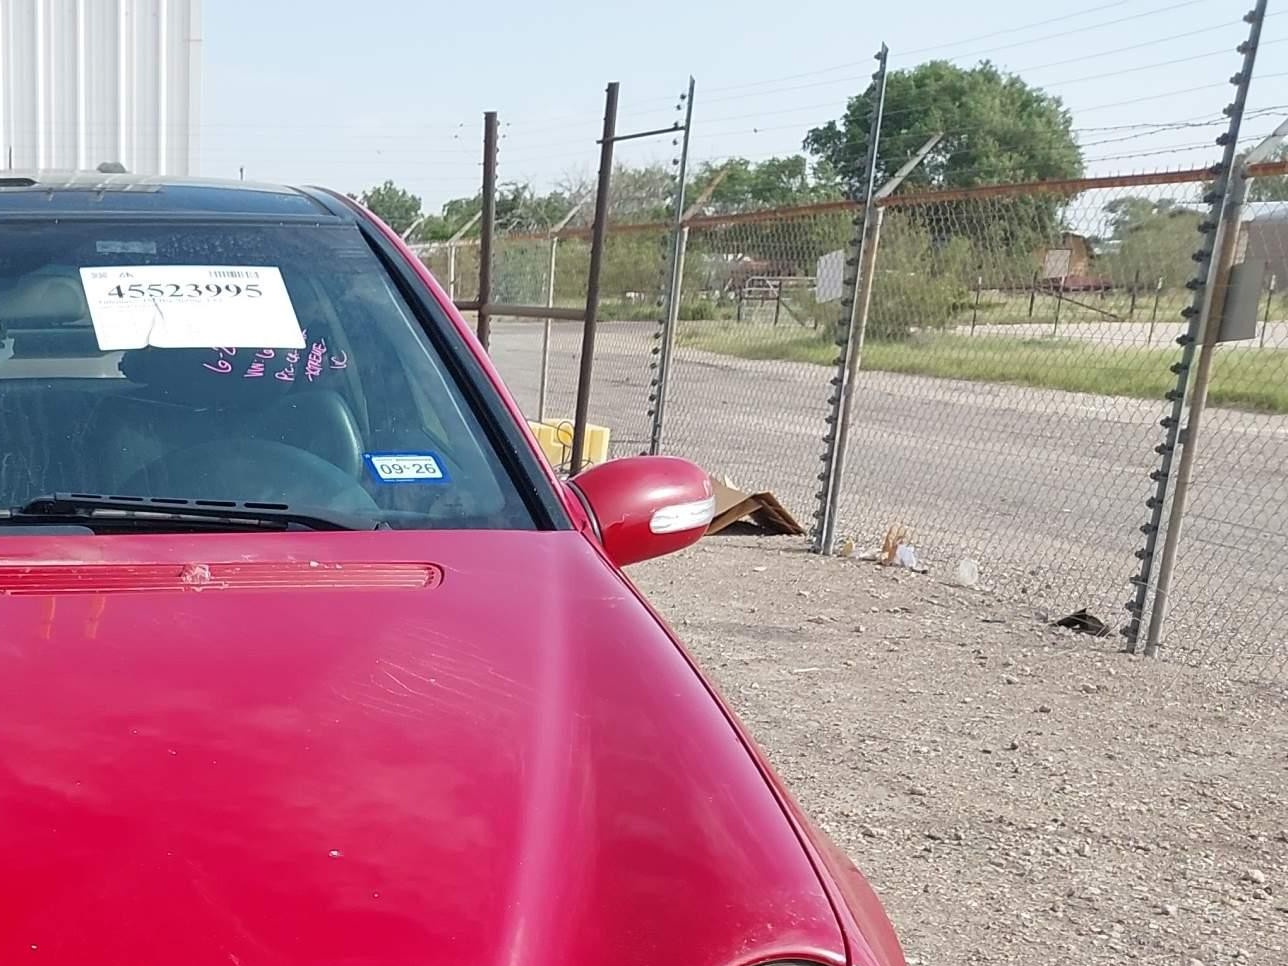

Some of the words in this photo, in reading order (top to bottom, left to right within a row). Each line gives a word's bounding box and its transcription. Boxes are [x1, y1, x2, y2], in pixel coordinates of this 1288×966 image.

[108, 283, 263, 299] 45523995
[379, 463, 404, 475] 09
[412, 463, 436, 474] 26
